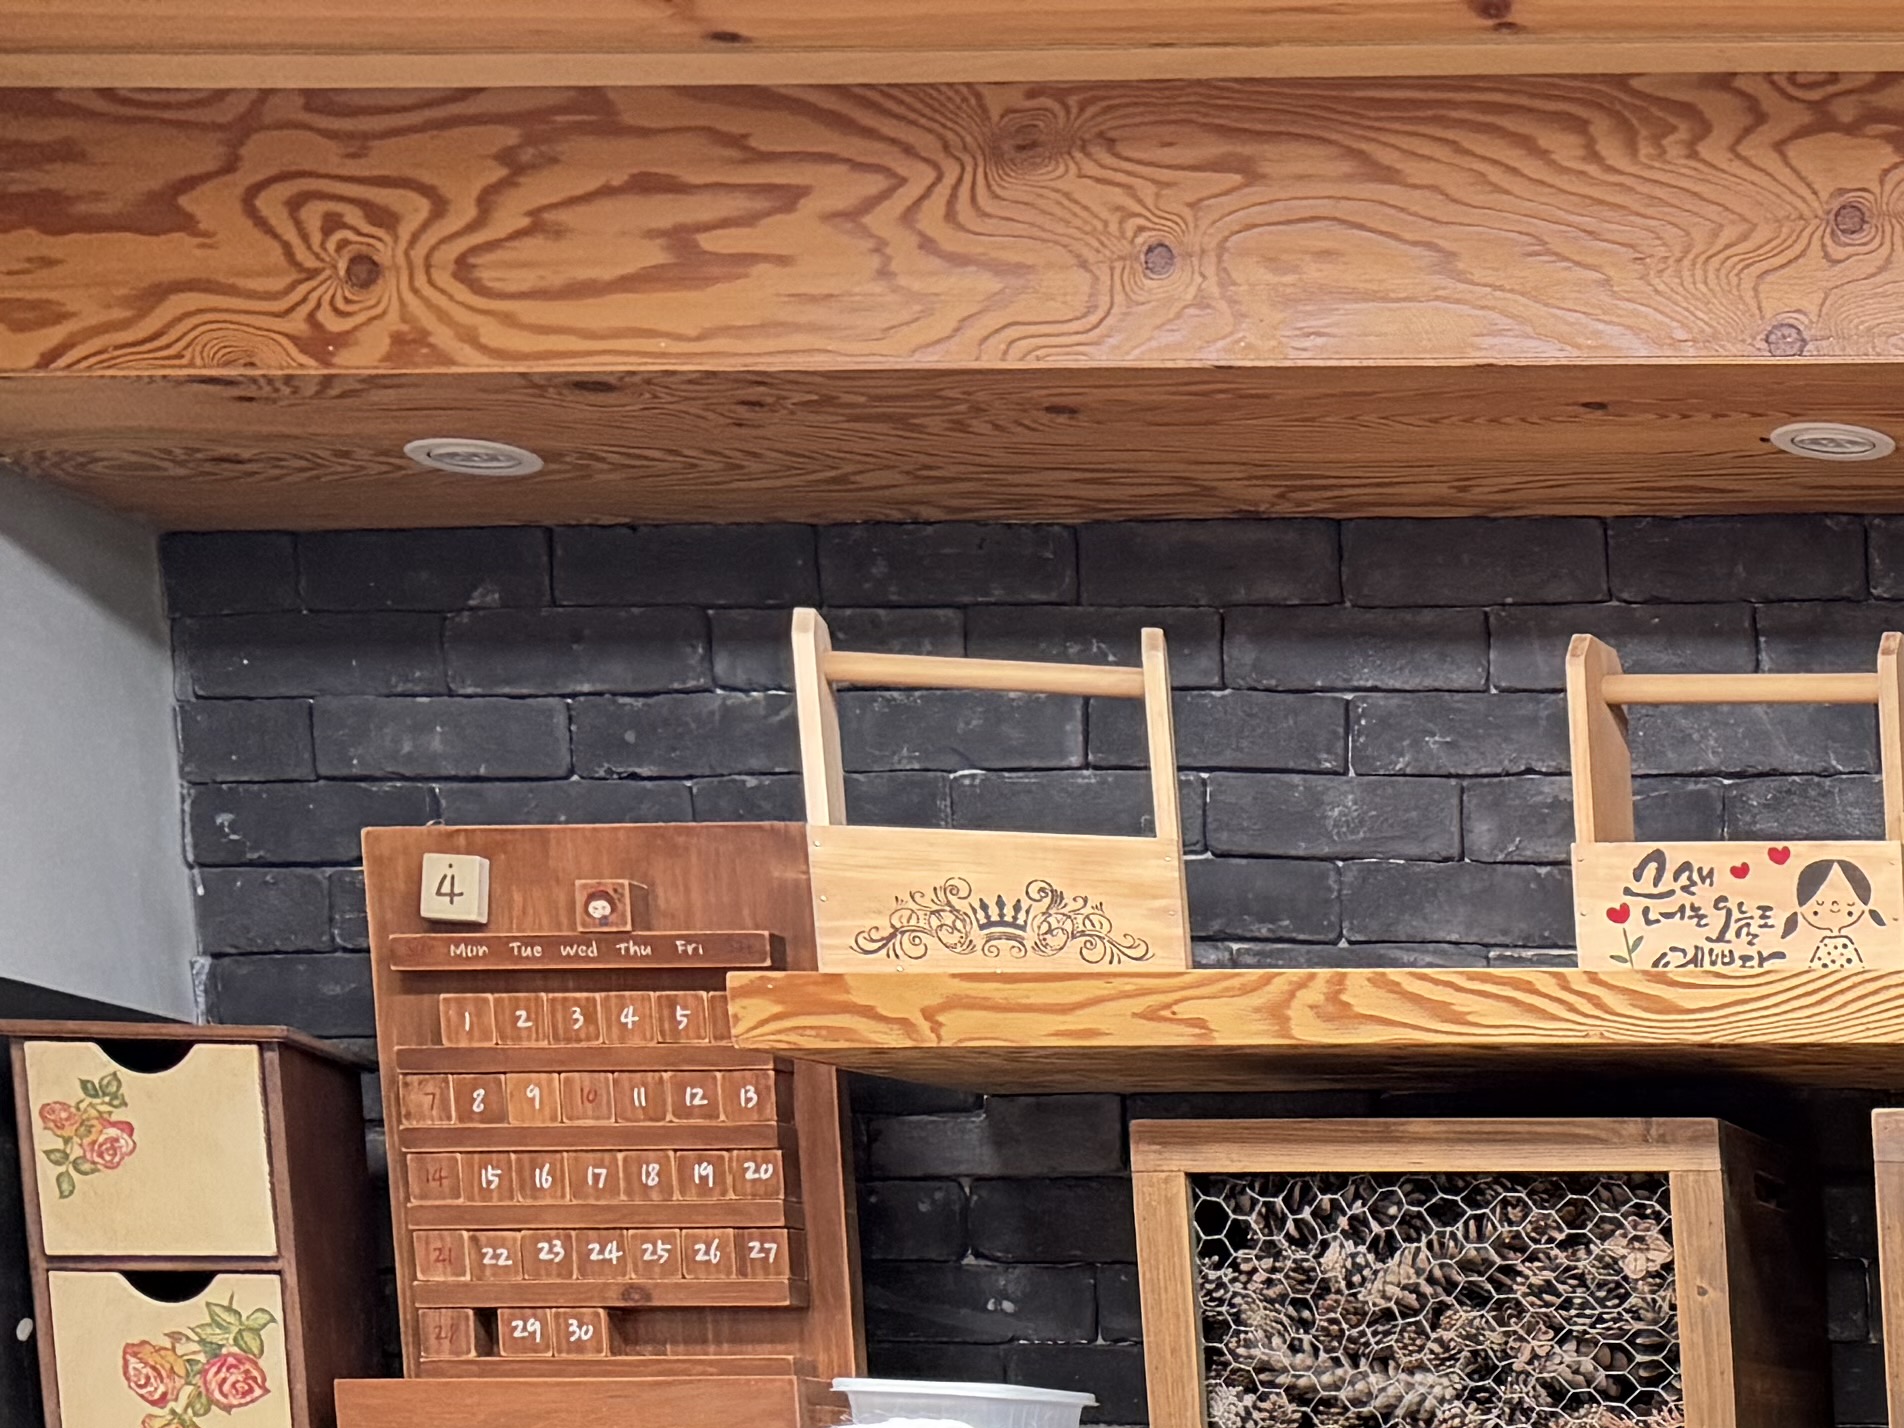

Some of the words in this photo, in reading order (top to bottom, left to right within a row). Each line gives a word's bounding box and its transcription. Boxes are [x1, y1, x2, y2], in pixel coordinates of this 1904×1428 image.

[1622, 848, 1715, 901] 그래
[449, 942, 489, 958] Mon
[508, 941, 543, 957] Tue
[615, 941, 653, 957] Thu
[674, 940, 704, 956] Fri
[464, 1010, 471, 1032] 1
[515, 1009, 534, 1029] 2
[570, 1007, 585, 1030] 3
[619, 1005, 640, 1030] 4
[675, 1005, 692, 1030] 5
[471, 1087, 486, 1113] 8
[525, 1084, 540, 1110] 9
[633, 1086, 647, 1108] 11
[684, 1086, 709, 1107] 12
[739, 1084, 759, 1109] 13
[480, 1167, 503, 1189] 15
[534, 1163, 553, 1189] 16
[586, 1165, 608, 1189] 17
[640, 1162, 661, 1187] 18
[692, 1162, 715, 1188] 19
[742, 1160, 775, 1181] 20
[480, 1247, 513, 1266] 22
[536, 1239, 566, 1261] 23
[587, 1240, 624, 1266] 24
[640, 1240, 673, 1265] 25
[693, 1237, 722, 1263] 26
[746, 1239, 779, 1264] 27
[511, 1318, 542, 1344] 29
[567, 1318, 594, 1341] 30
